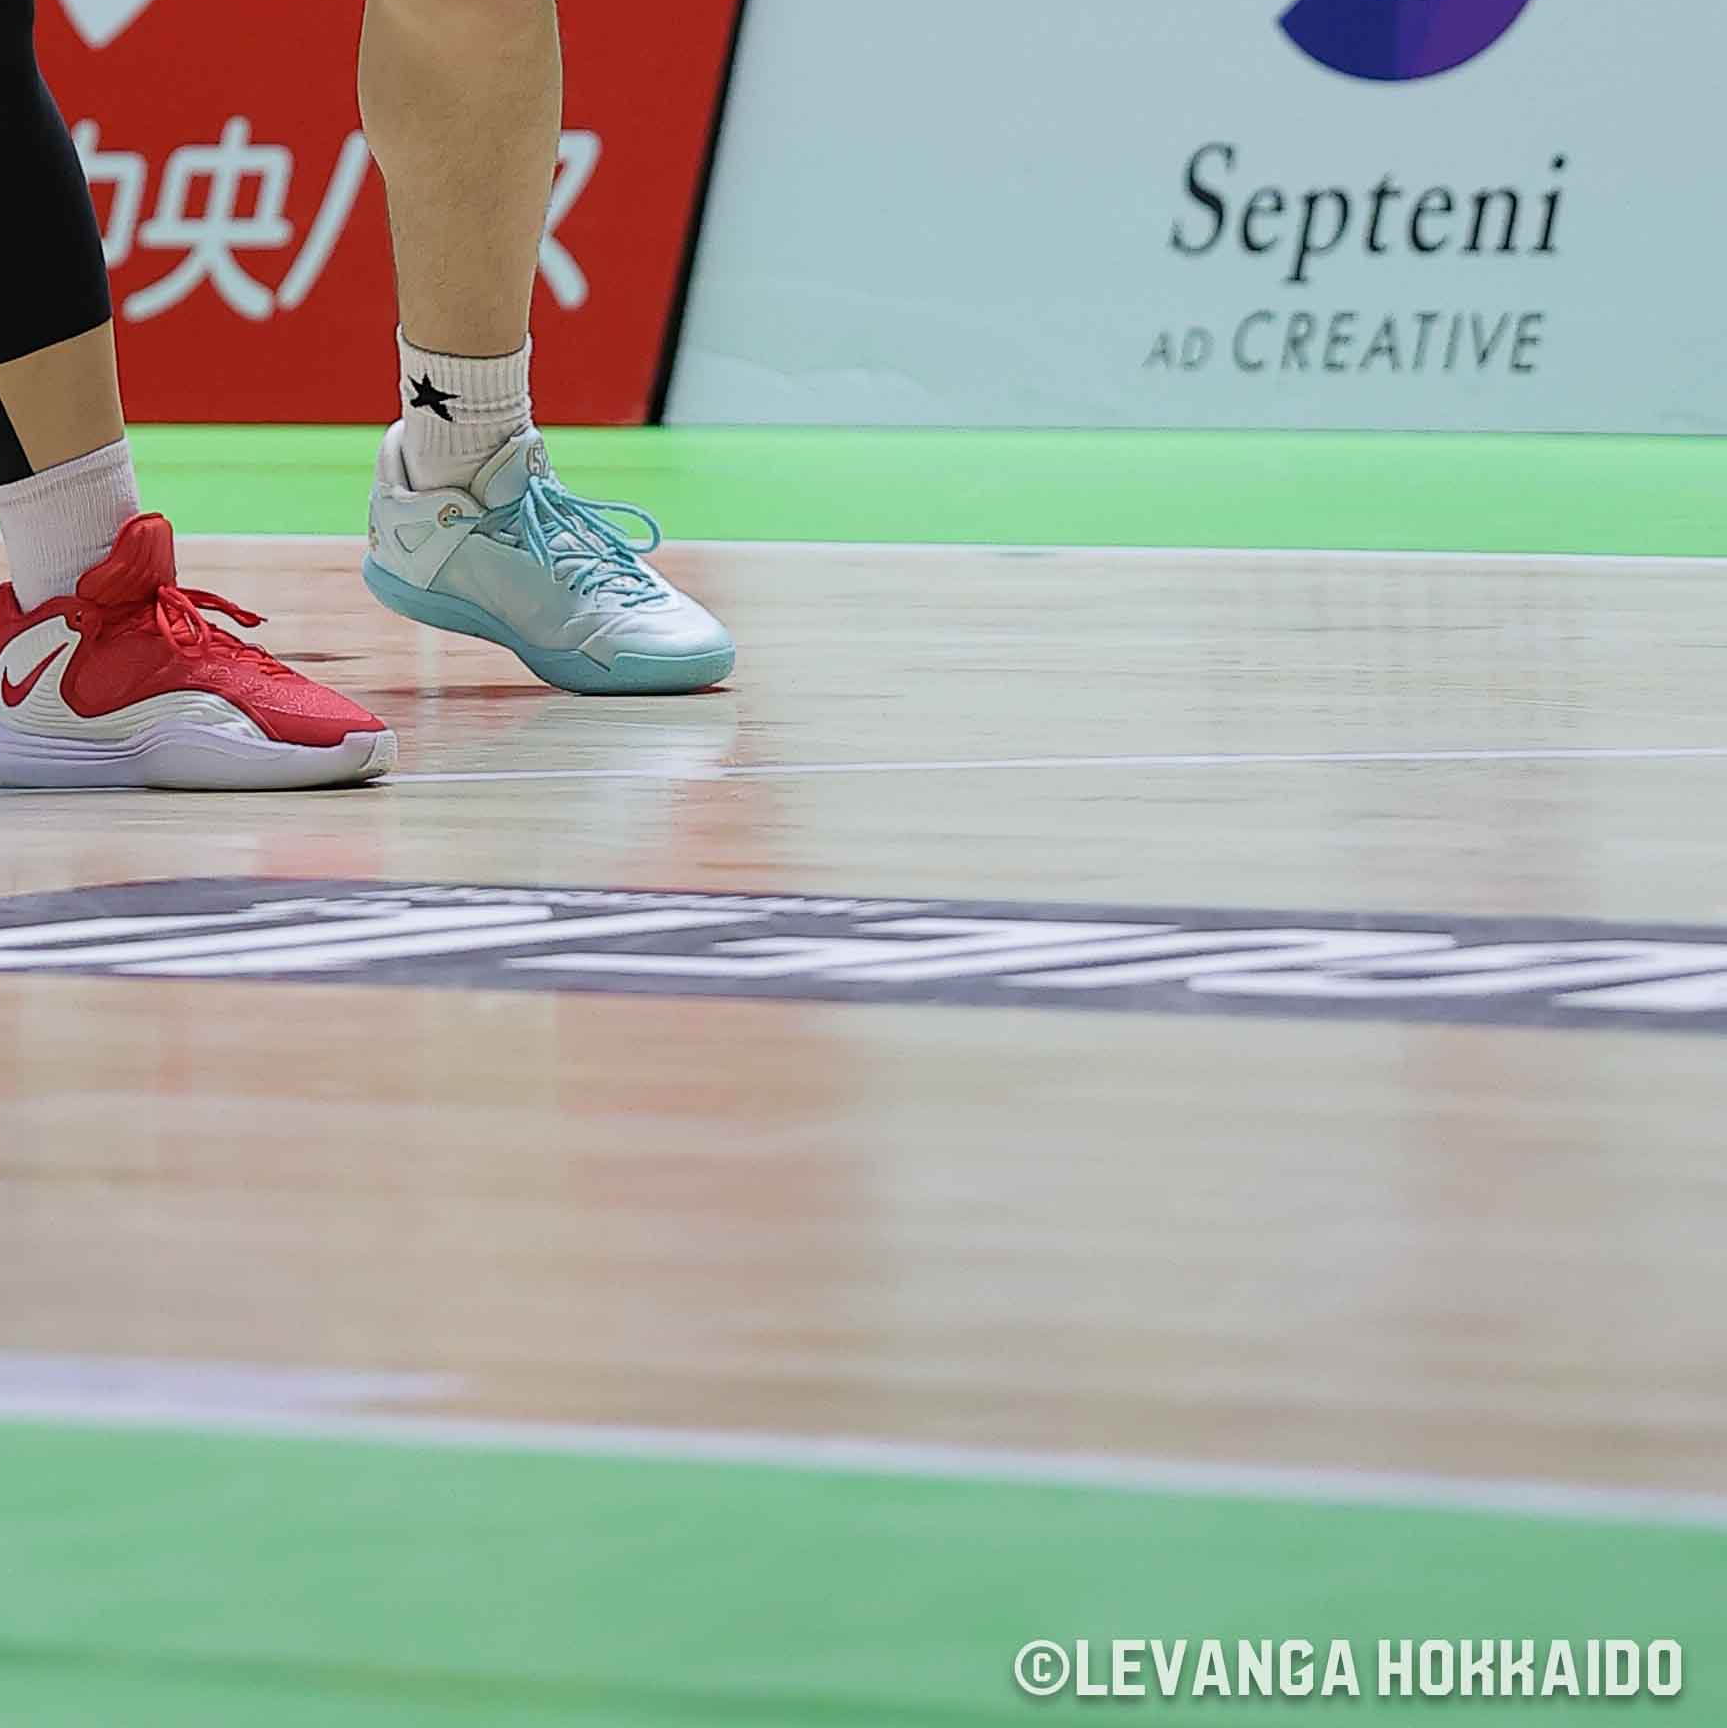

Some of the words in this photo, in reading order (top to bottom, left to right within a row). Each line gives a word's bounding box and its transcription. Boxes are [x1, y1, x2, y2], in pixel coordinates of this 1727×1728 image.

[1170, 141, 1569, 285] Septeni
[1140, 325, 1215, 373] AD
[1231, 307, 1547, 375] CREATIVE
